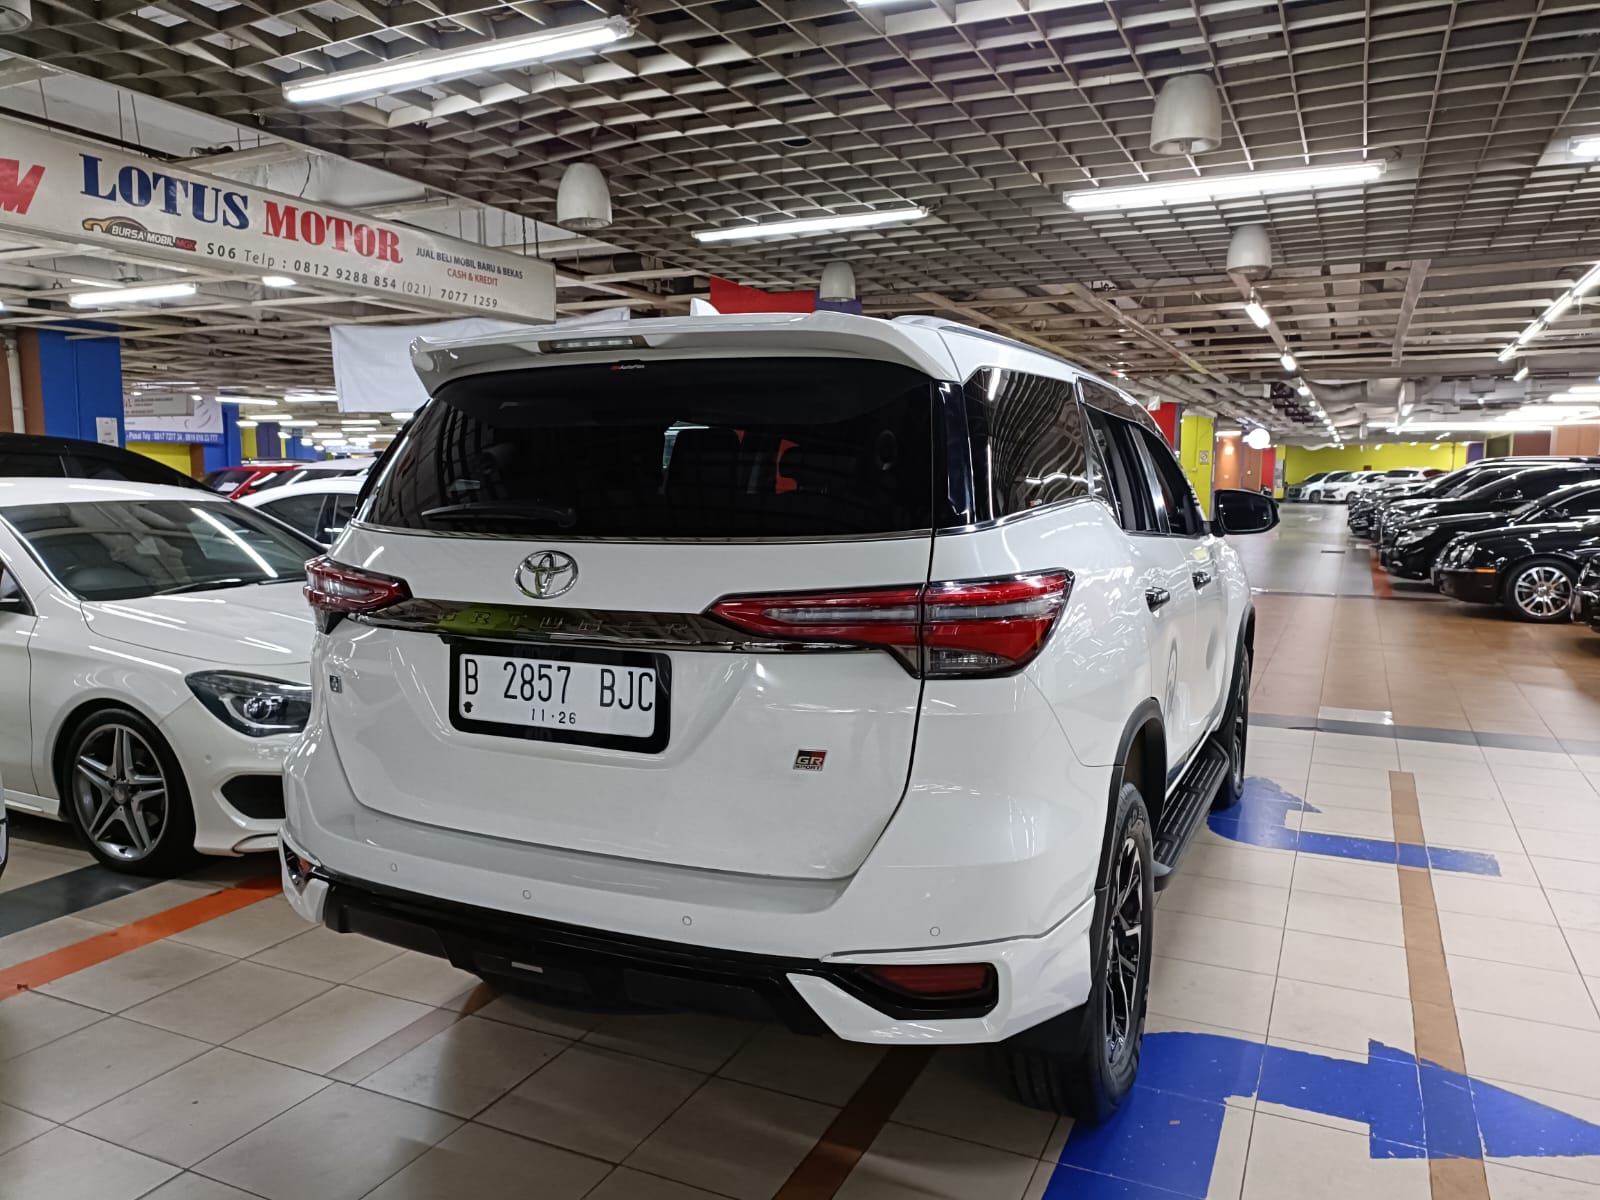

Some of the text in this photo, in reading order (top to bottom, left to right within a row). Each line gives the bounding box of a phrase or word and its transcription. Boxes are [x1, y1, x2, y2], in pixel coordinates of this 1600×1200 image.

[79, 153, 403, 264] LOTUS MOTOR
[111, 225, 144, 240] BURSA
[146, 232, 174, 247] MOBIL
[206, 242, 236, 259] S06
[294, 260, 329, 276] 0812
[336, 268, 368, 284] 9288
[374, 275, 396, 289] 854
[402, 281, 432, 297] (021)
[440, 288, 468, 303] 7077
[473, 294, 498, 308] 1259
[416, 247, 523, 279] JUAL BELI MOBIL BARU & BEKAS
[447, 268, 498, 286] CASH & KREDIT
[464, 658, 653, 712] B 2857 BJC
[797, 756, 823, 766] GR
